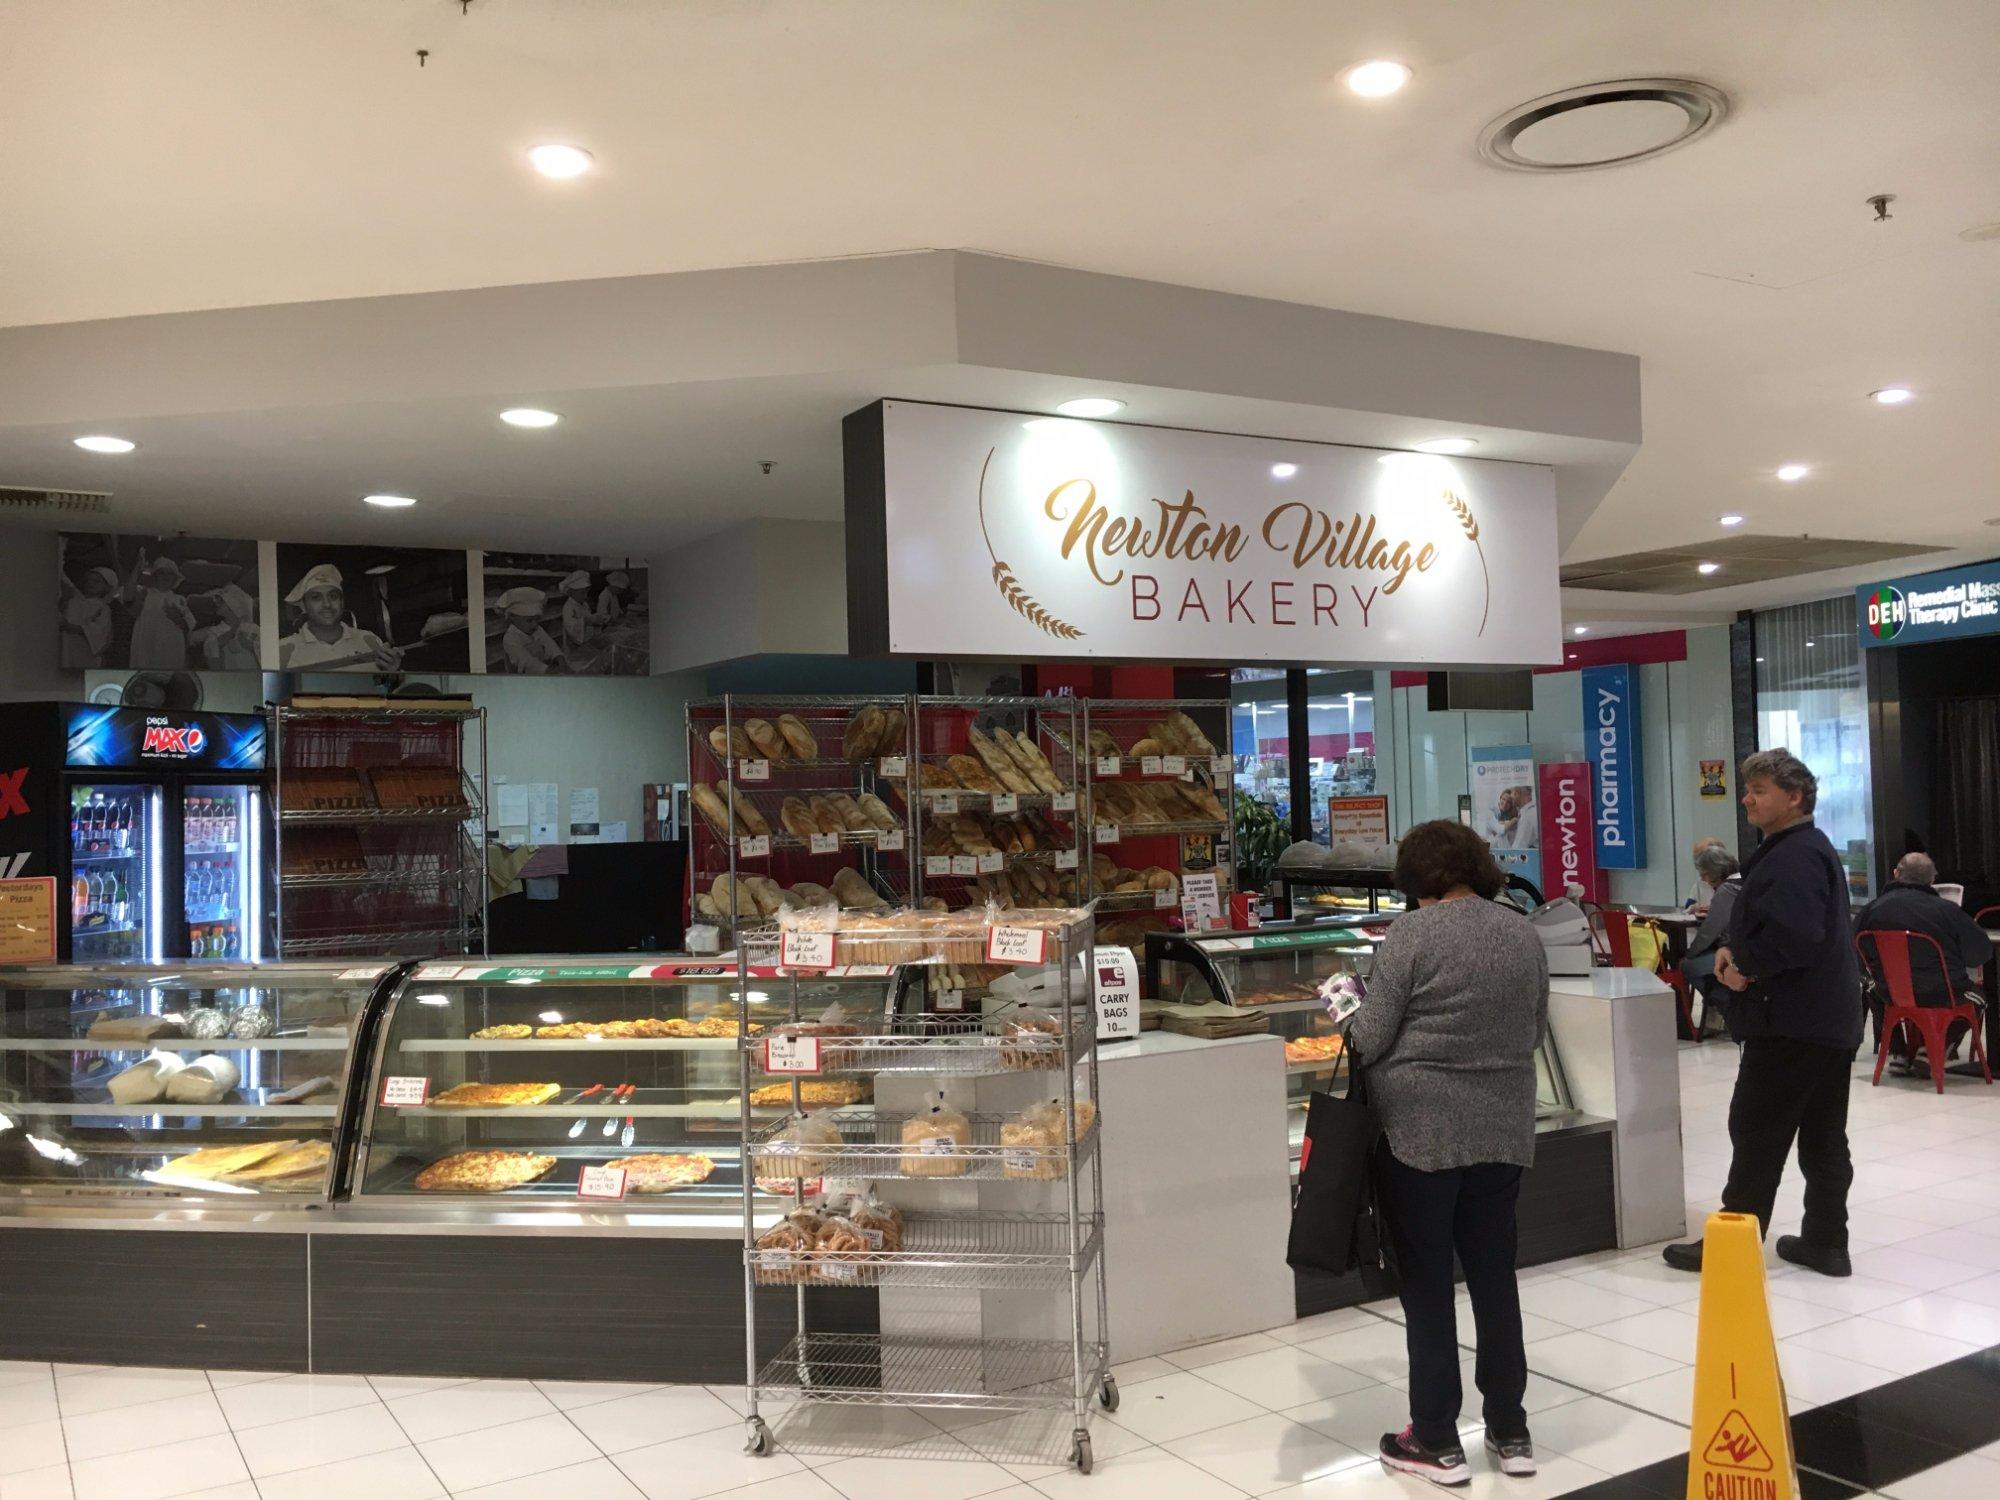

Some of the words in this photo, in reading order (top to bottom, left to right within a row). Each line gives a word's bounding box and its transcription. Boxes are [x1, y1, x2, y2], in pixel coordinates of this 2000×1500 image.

[1044, 478, 1249, 586] Newton
[1262, 502, 1440, 595] Village
[1131, 574, 1378, 628] BAKERY
[1908, 584, 1966, 608] Remedial
[1868, 600, 1904, 625] DEH
[1909, 605, 1959, 625] Therapy
[1961, 597, 1998, 618] Clinic
[146, 716, 169, 726] pepsi
[142, 726, 188, 753] MAX
[1598, 688, 1625, 846] pharmacy
[1555, 778, 1579, 887] newton
[508, 968, 544, 976] Pizza
[1100, 994, 1130, 1004] CARRY
[1104, 1008, 1128, 1018] BAGS
[1107, 1022, 1118, 1032] 10
[1704, 1471, 1777, 1500] CAUTION
